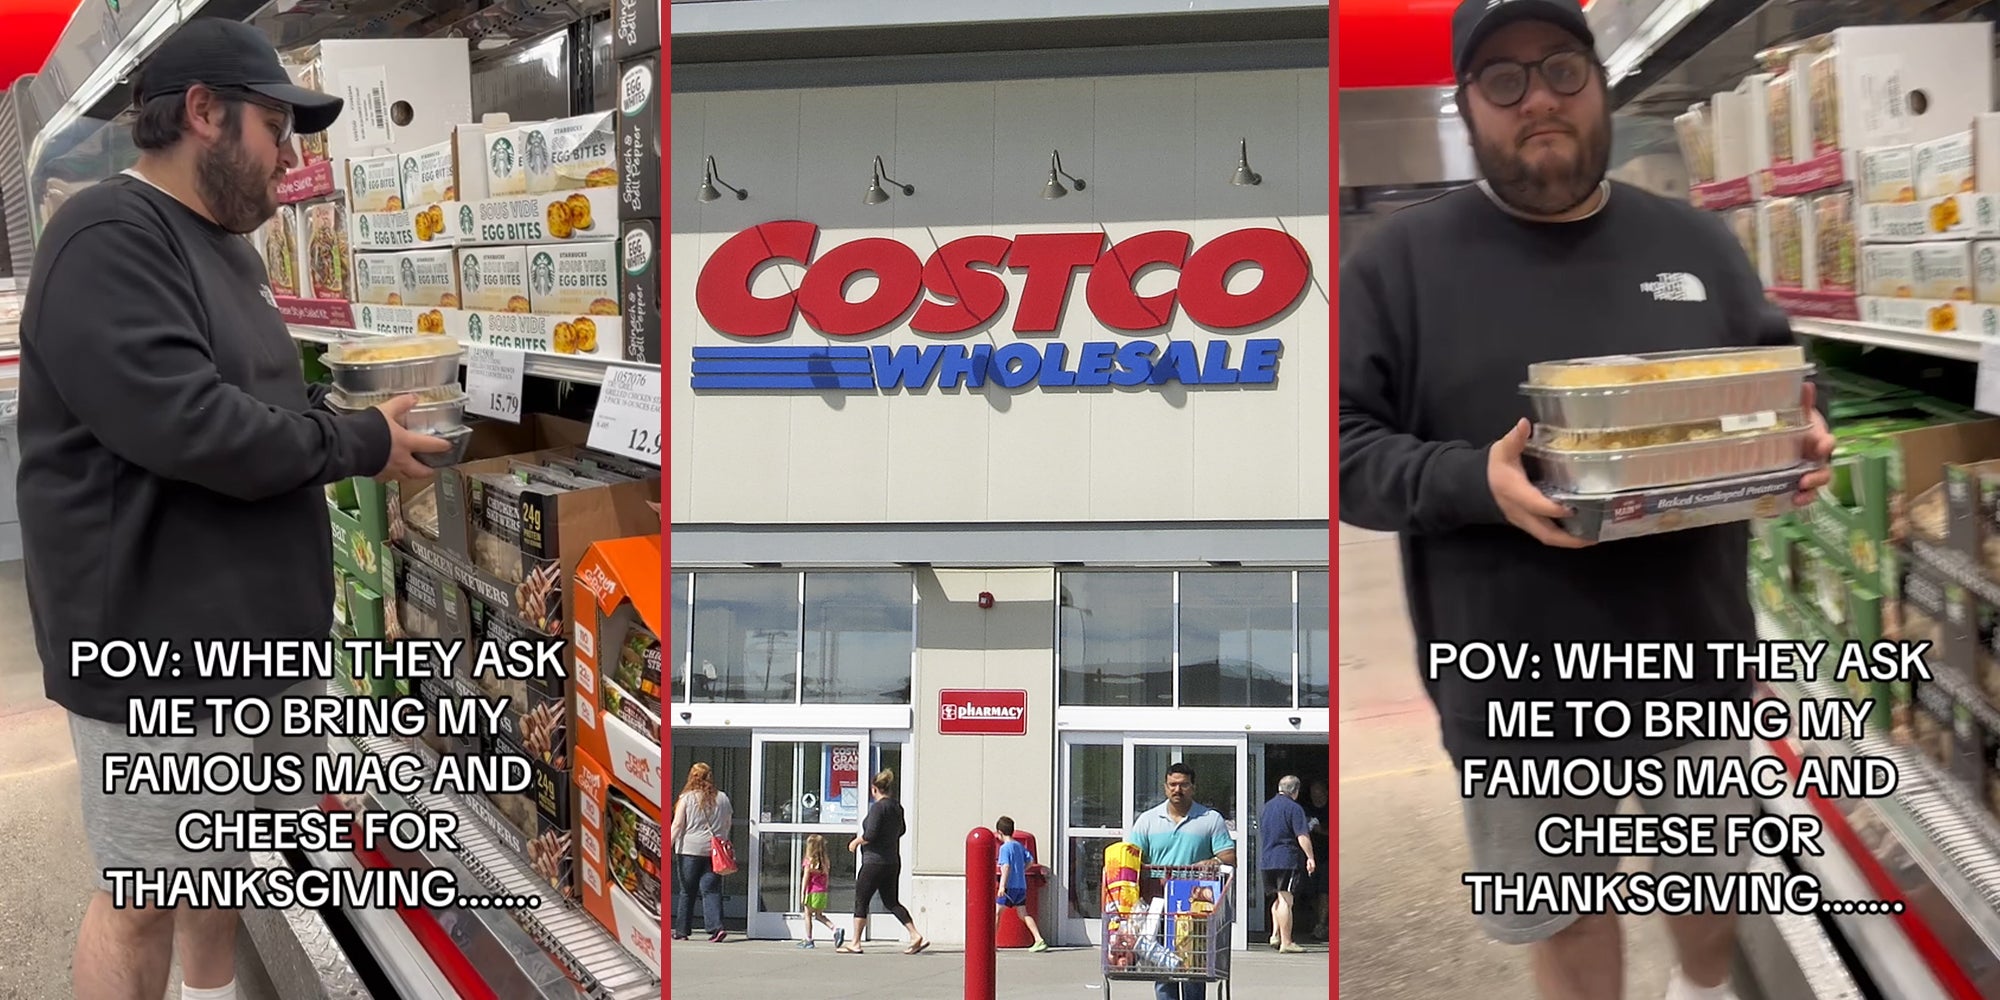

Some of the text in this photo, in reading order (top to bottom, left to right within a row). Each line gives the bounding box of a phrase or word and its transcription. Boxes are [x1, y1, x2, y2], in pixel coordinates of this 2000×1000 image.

[626, 76, 641, 97] EGG
[551, 143, 606, 164] EGG BITES
[421, 171, 434, 183] EGG
[622, 148, 633, 203] Spinach
[631, 125, 643, 211] Bell Pepper
[368, 178, 396, 190] EGG BITES
[480, 200, 539, 221] SOUS VIDE
[374, 231, 390, 245] EGG
[482, 222, 542, 241] EGG BITES
[628, 239, 643, 257] EGG
[418, 274, 449, 285] EGG BITES
[483, 274, 521, 286] EGG BITES
[559, 274, 607, 287] EGG BITES
[696, 220, 1311, 337] COSTCO
[489, 315, 546, 334] SOUS VIDE
[490, 335, 546, 352] EGG BITES
[870, 338, 1284, 390] WHOLESALE
[490, 392, 519, 414] 15.79
[1657, 494, 1694, 509] Baked
[1694, 487, 1745, 503] Scalloped
[1745, 481, 1789, 497] Potatoes
[487, 496, 520, 519] CHICKEN
[522, 502, 541, 531] 24g
[486, 508, 520, 532] SKEWERS
[411, 540, 454, 579] CHICKEN
[453, 565, 510, 607] SKEWERS
[405, 582, 437, 609] SKEWERS
[406, 573, 436, 597] CHICKEN
[536, 768, 555, 800] 24g
[465, 793, 521, 853] SKEWERS
